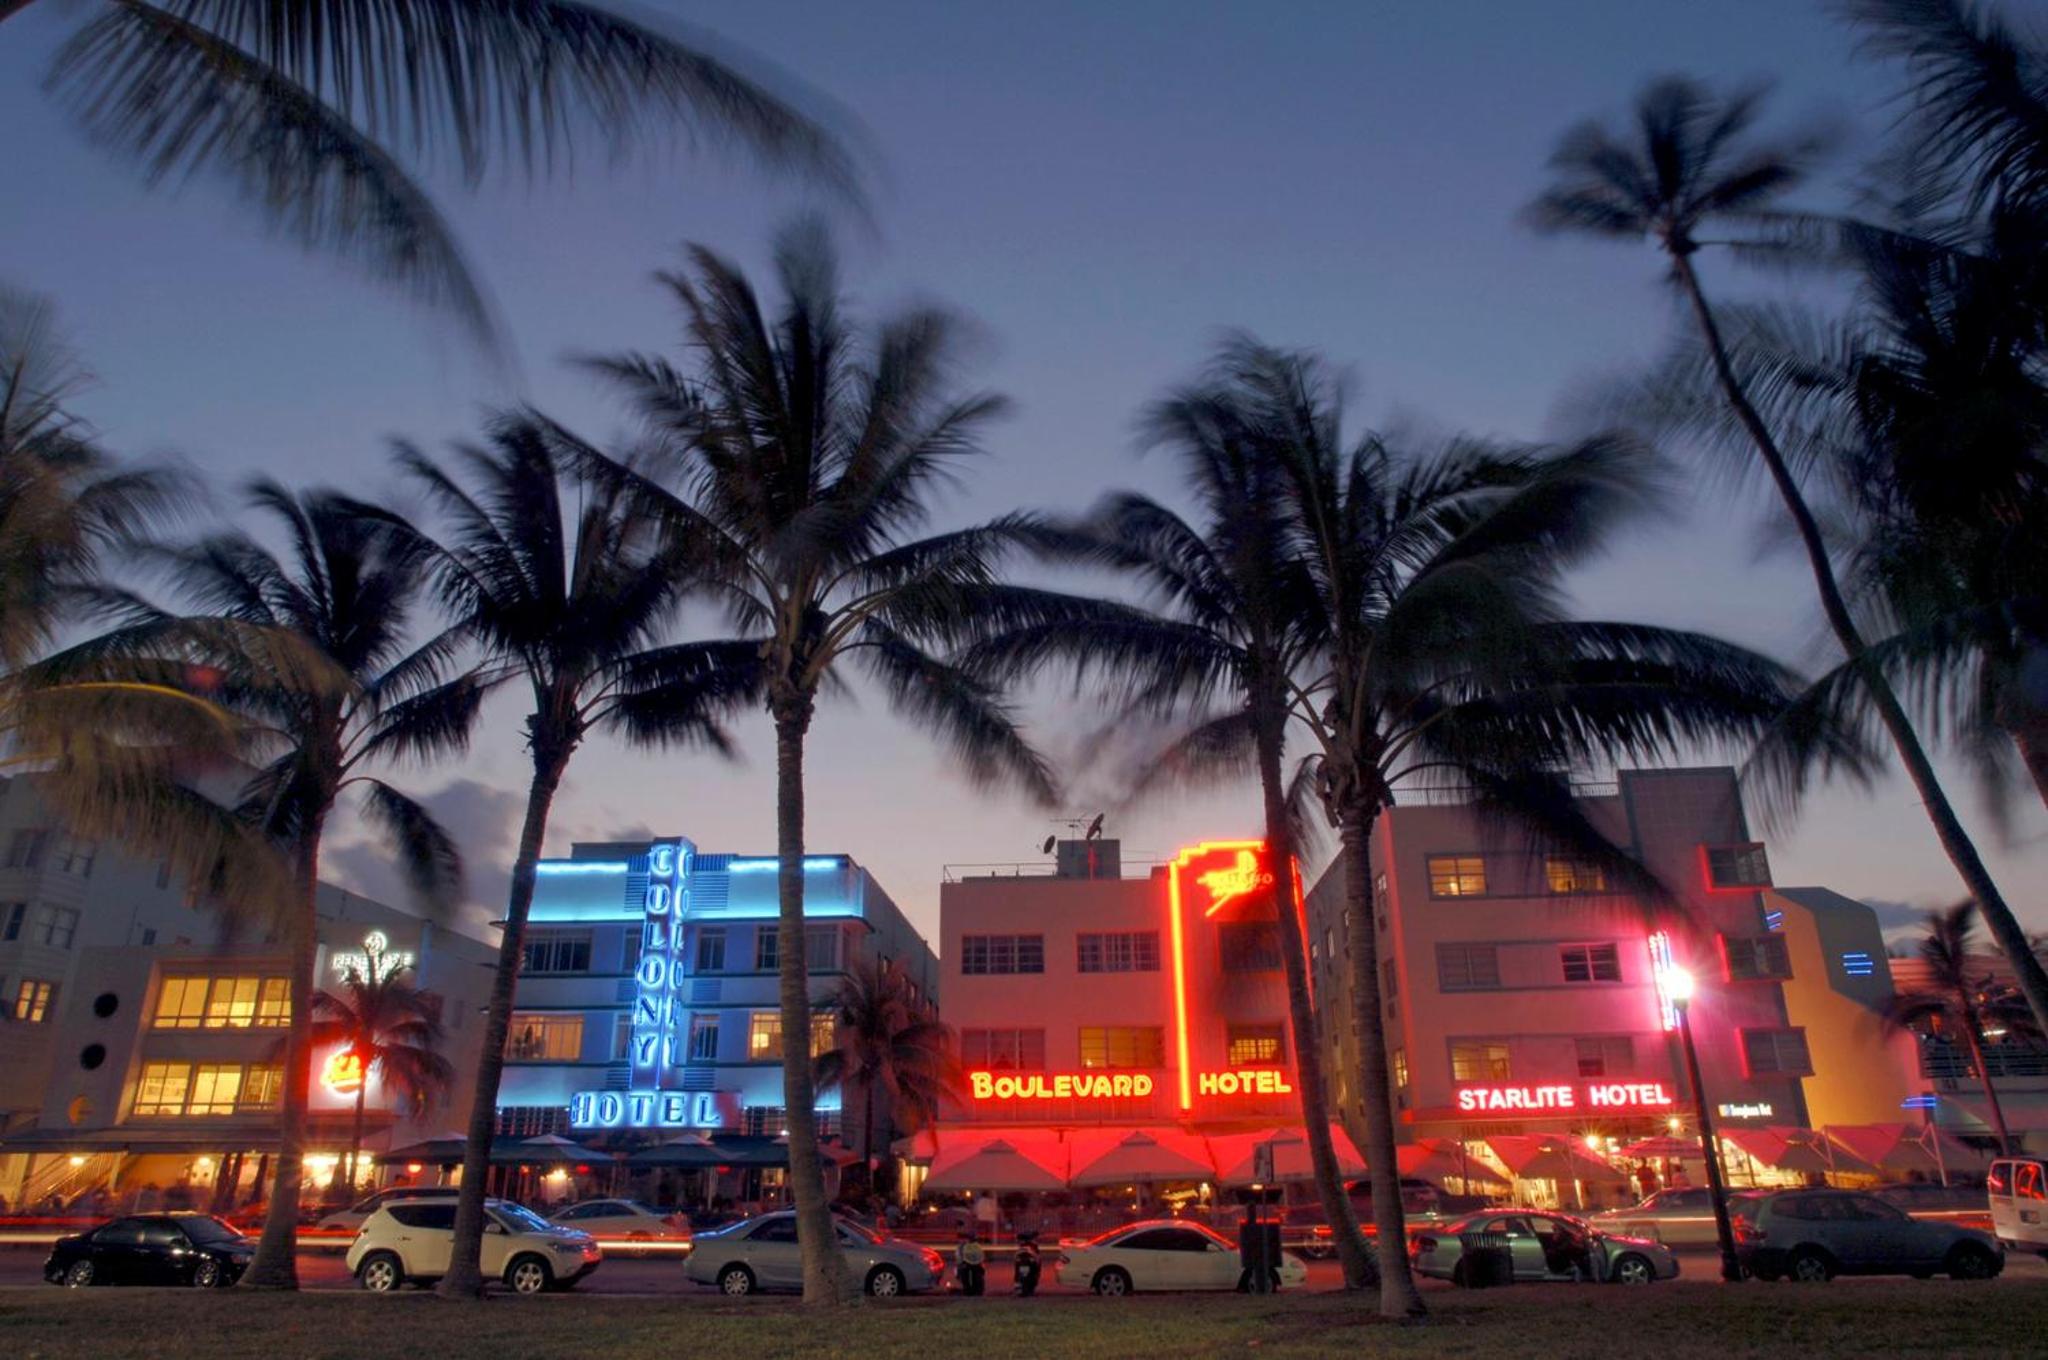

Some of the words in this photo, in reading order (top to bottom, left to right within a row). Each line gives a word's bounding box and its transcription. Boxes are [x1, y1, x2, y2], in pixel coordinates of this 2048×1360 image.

[636, 844, 674, 1067] COLONY
[971, 1072, 1152, 1099] BOULEVARD
[1199, 1071, 1292, 1095] HOTEL
[1458, 1086, 1574, 1110] STARLITE
[1590, 1084, 1672, 1106] HOTEL
[571, 1091, 720, 1127] HOTEL
